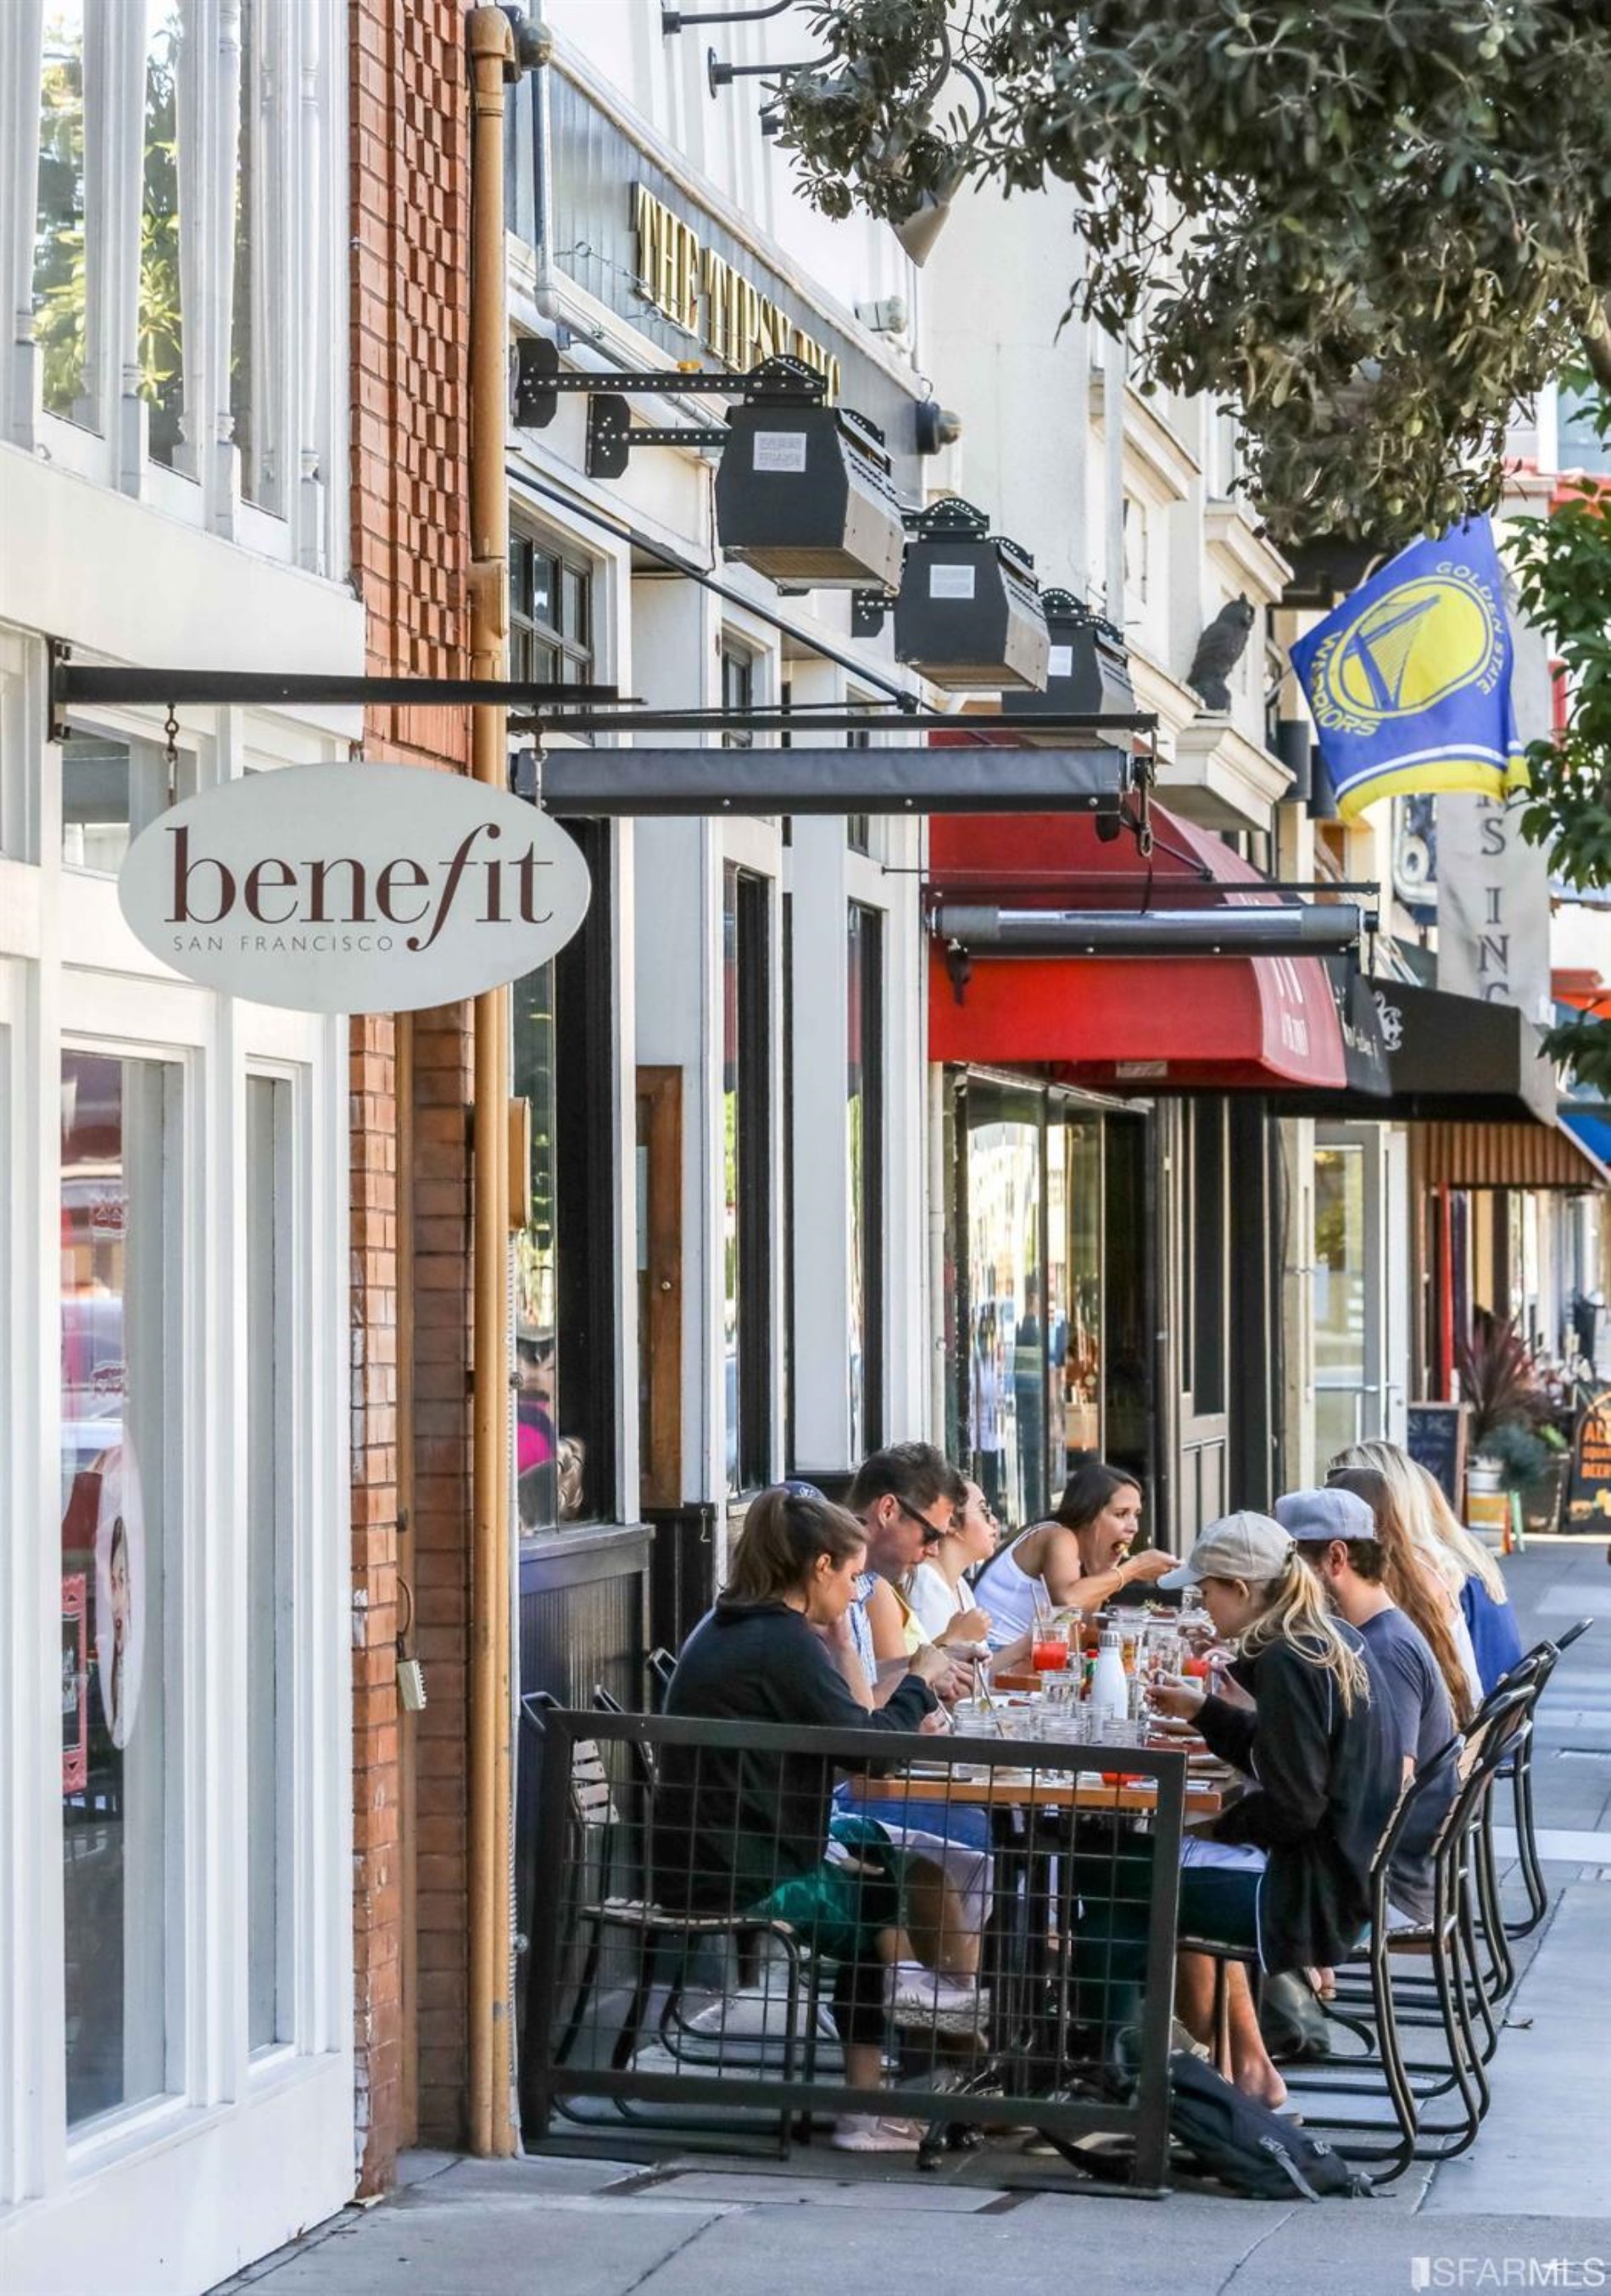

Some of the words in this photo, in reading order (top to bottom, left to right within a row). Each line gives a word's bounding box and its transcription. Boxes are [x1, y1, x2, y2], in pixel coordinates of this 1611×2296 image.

[630, 181, 700, 338] THE
[1435, 561, 1504, 633] GOLDEN
[1476, 640, 1504, 695] STATE
[164, 822, 554, 952] benefit
[173, 936, 222, 952] SAN
[241, 935, 393, 952] FRANCISCO
